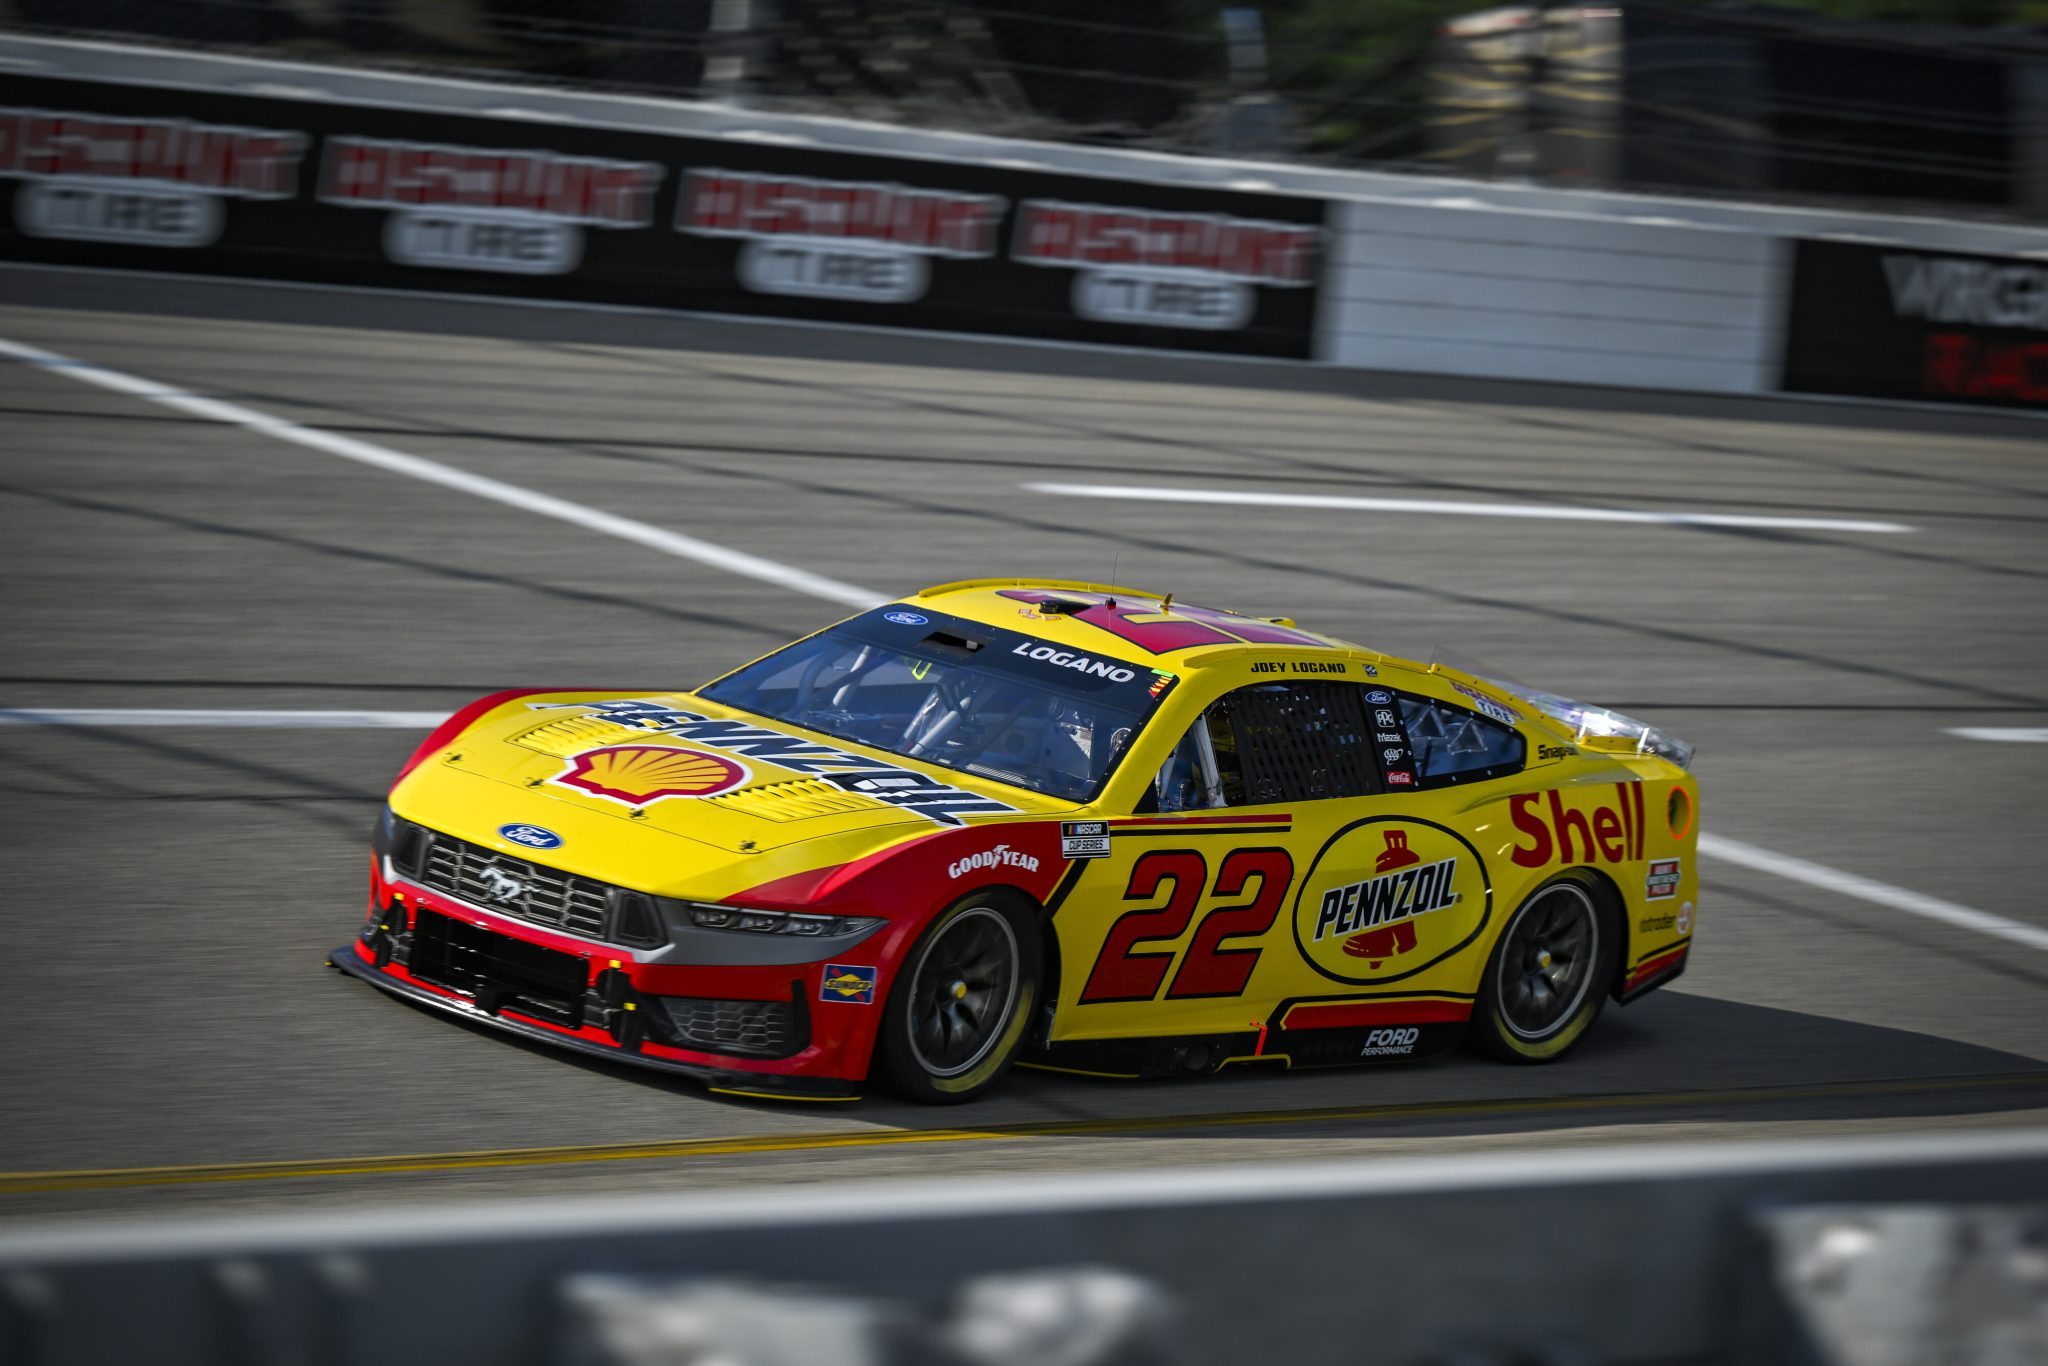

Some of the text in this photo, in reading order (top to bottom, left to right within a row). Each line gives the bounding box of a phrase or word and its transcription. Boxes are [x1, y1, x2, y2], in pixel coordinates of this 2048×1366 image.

[889, 612, 923, 625] Ford
[1012, 642, 1135, 683] LOGANO
[1250, 662, 1346, 674] JOEY LOGANO
[1370, 691, 1387, 702] Ford
[1377, 711, 1394, 725] PPG
[525, 699, 1025, 828] PENNZOIL
[1077, 823, 1103, 835] NASCAR
[1510, 781, 1645, 868] Shell
[504, 826, 555, 847] Ford
[1069, 839, 1104, 850] CUP SERIES
[1312, 857, 1458, 943] PENNZOIL
[1077, 846, 1295, 1006] 22
[1365, 1027, 1419, 1047] FORD
[1361, 1045, 1413, 1056] PERFORMANCE
